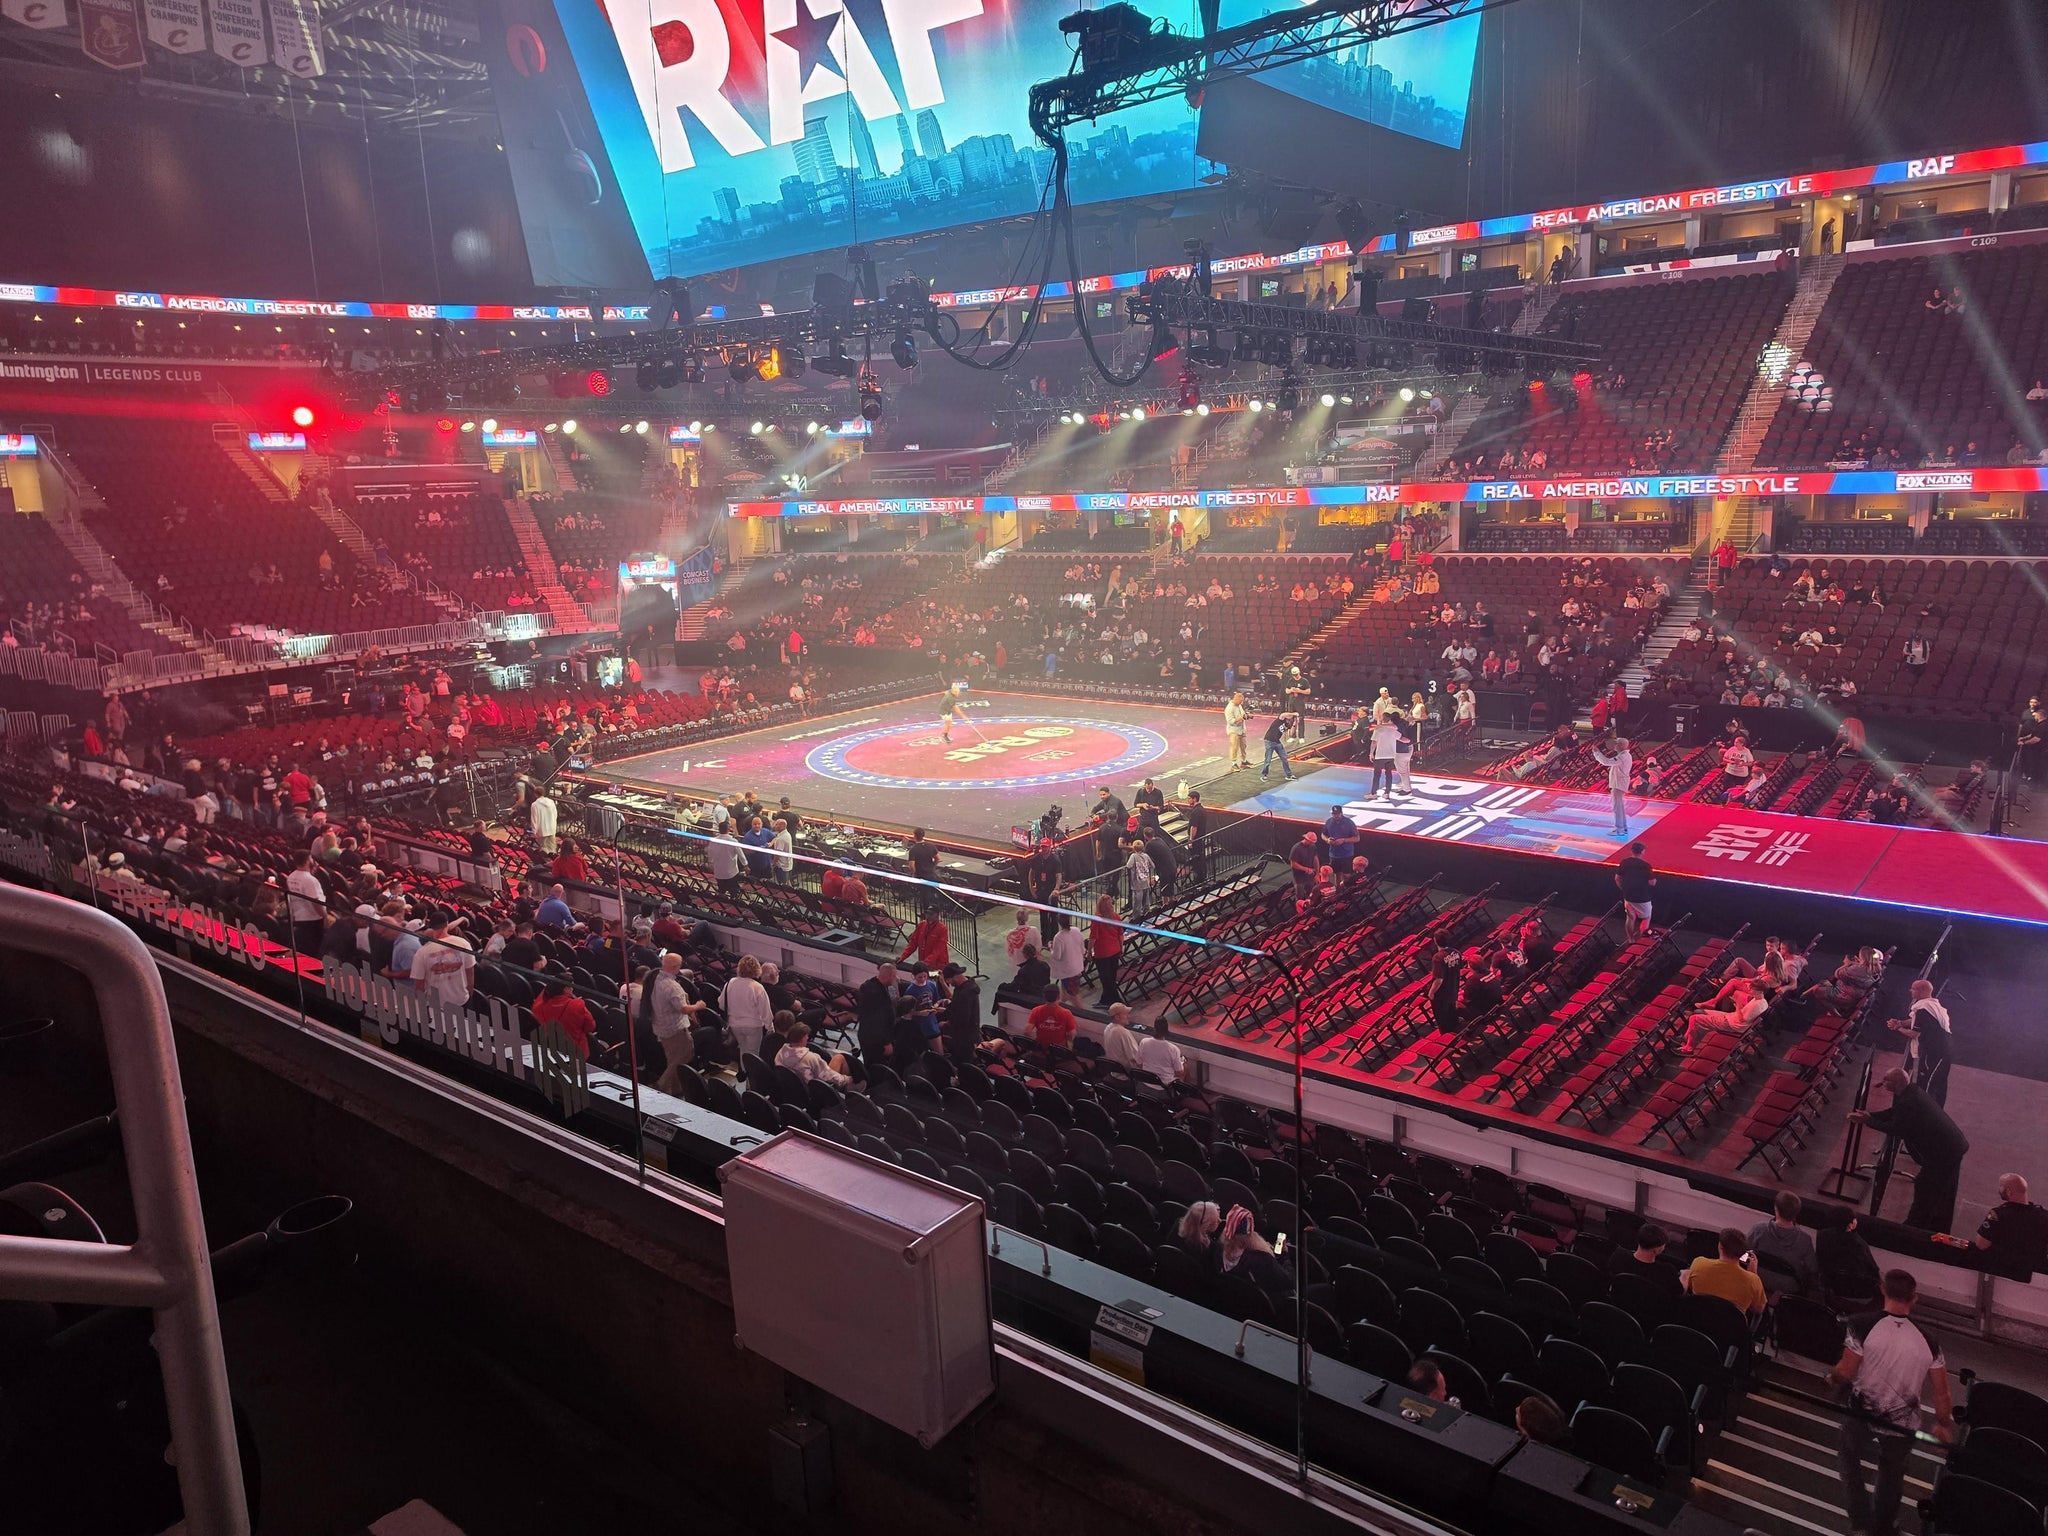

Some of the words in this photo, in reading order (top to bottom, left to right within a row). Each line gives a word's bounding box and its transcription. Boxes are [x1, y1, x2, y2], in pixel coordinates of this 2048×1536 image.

[150, 9, 198, 26] CHAMPIONS
[212, 10, 261, 29] CONFERENCE
[216, 23, 261, 40] CHAMPIONS
[1907, 156, 1955, 178] RAF
[1532, 212, 1579, 228] REAL
[1586, 196, 1680, 221] AMERICAN
[1689, 178, 1812, 206] FREESTYLE
[1413, 232, 1430, 244] FOX
[956, 288, 1028, 304] FREESTYLE
[115, 294, 162, 307] REAL
[168, 297, 247, 312] AMERICAN
[253, 302, 348, 315] FREESTYLE
[407, 305, 437, 317] RAF
[512, 308, 550, 318] REAL
[95, 368, 161, 381] LEGENDS
[166, 370, 202, 381] CLUB
[1483, 485, 1534, 498] REAL
[1543, 481, 1648, 496] AMERICAN
[1659, 477, 1799, 494] FREESTYLE
[1896, 476, 1925, 488] FOX
[1926, 475, 1973, 485] NATION
[1090, 497, 1125, 507] REAL
[1130, 494, 1199, 507] AMERICAN
[1206, 492, 1297, 505] FREESTYLE
[1366, 486, 1400, 501] RAF
[799, 504, 833, 514] REAL
[839, 502, 901, 513] AMERICAN
[906, 500, 974, 511] FREESTYLE
[683, 570, 709, 579] COMCAST
[684, 577, 710, 585] BUSINESS
[560, 662, 568, 673] 6
[1428, 680, 1437, 693] 3
[342, 692, 350, 705] 7
[1691, 823, 1774, 862] RAF
[1134, 1322, 1149, 1332] Date
